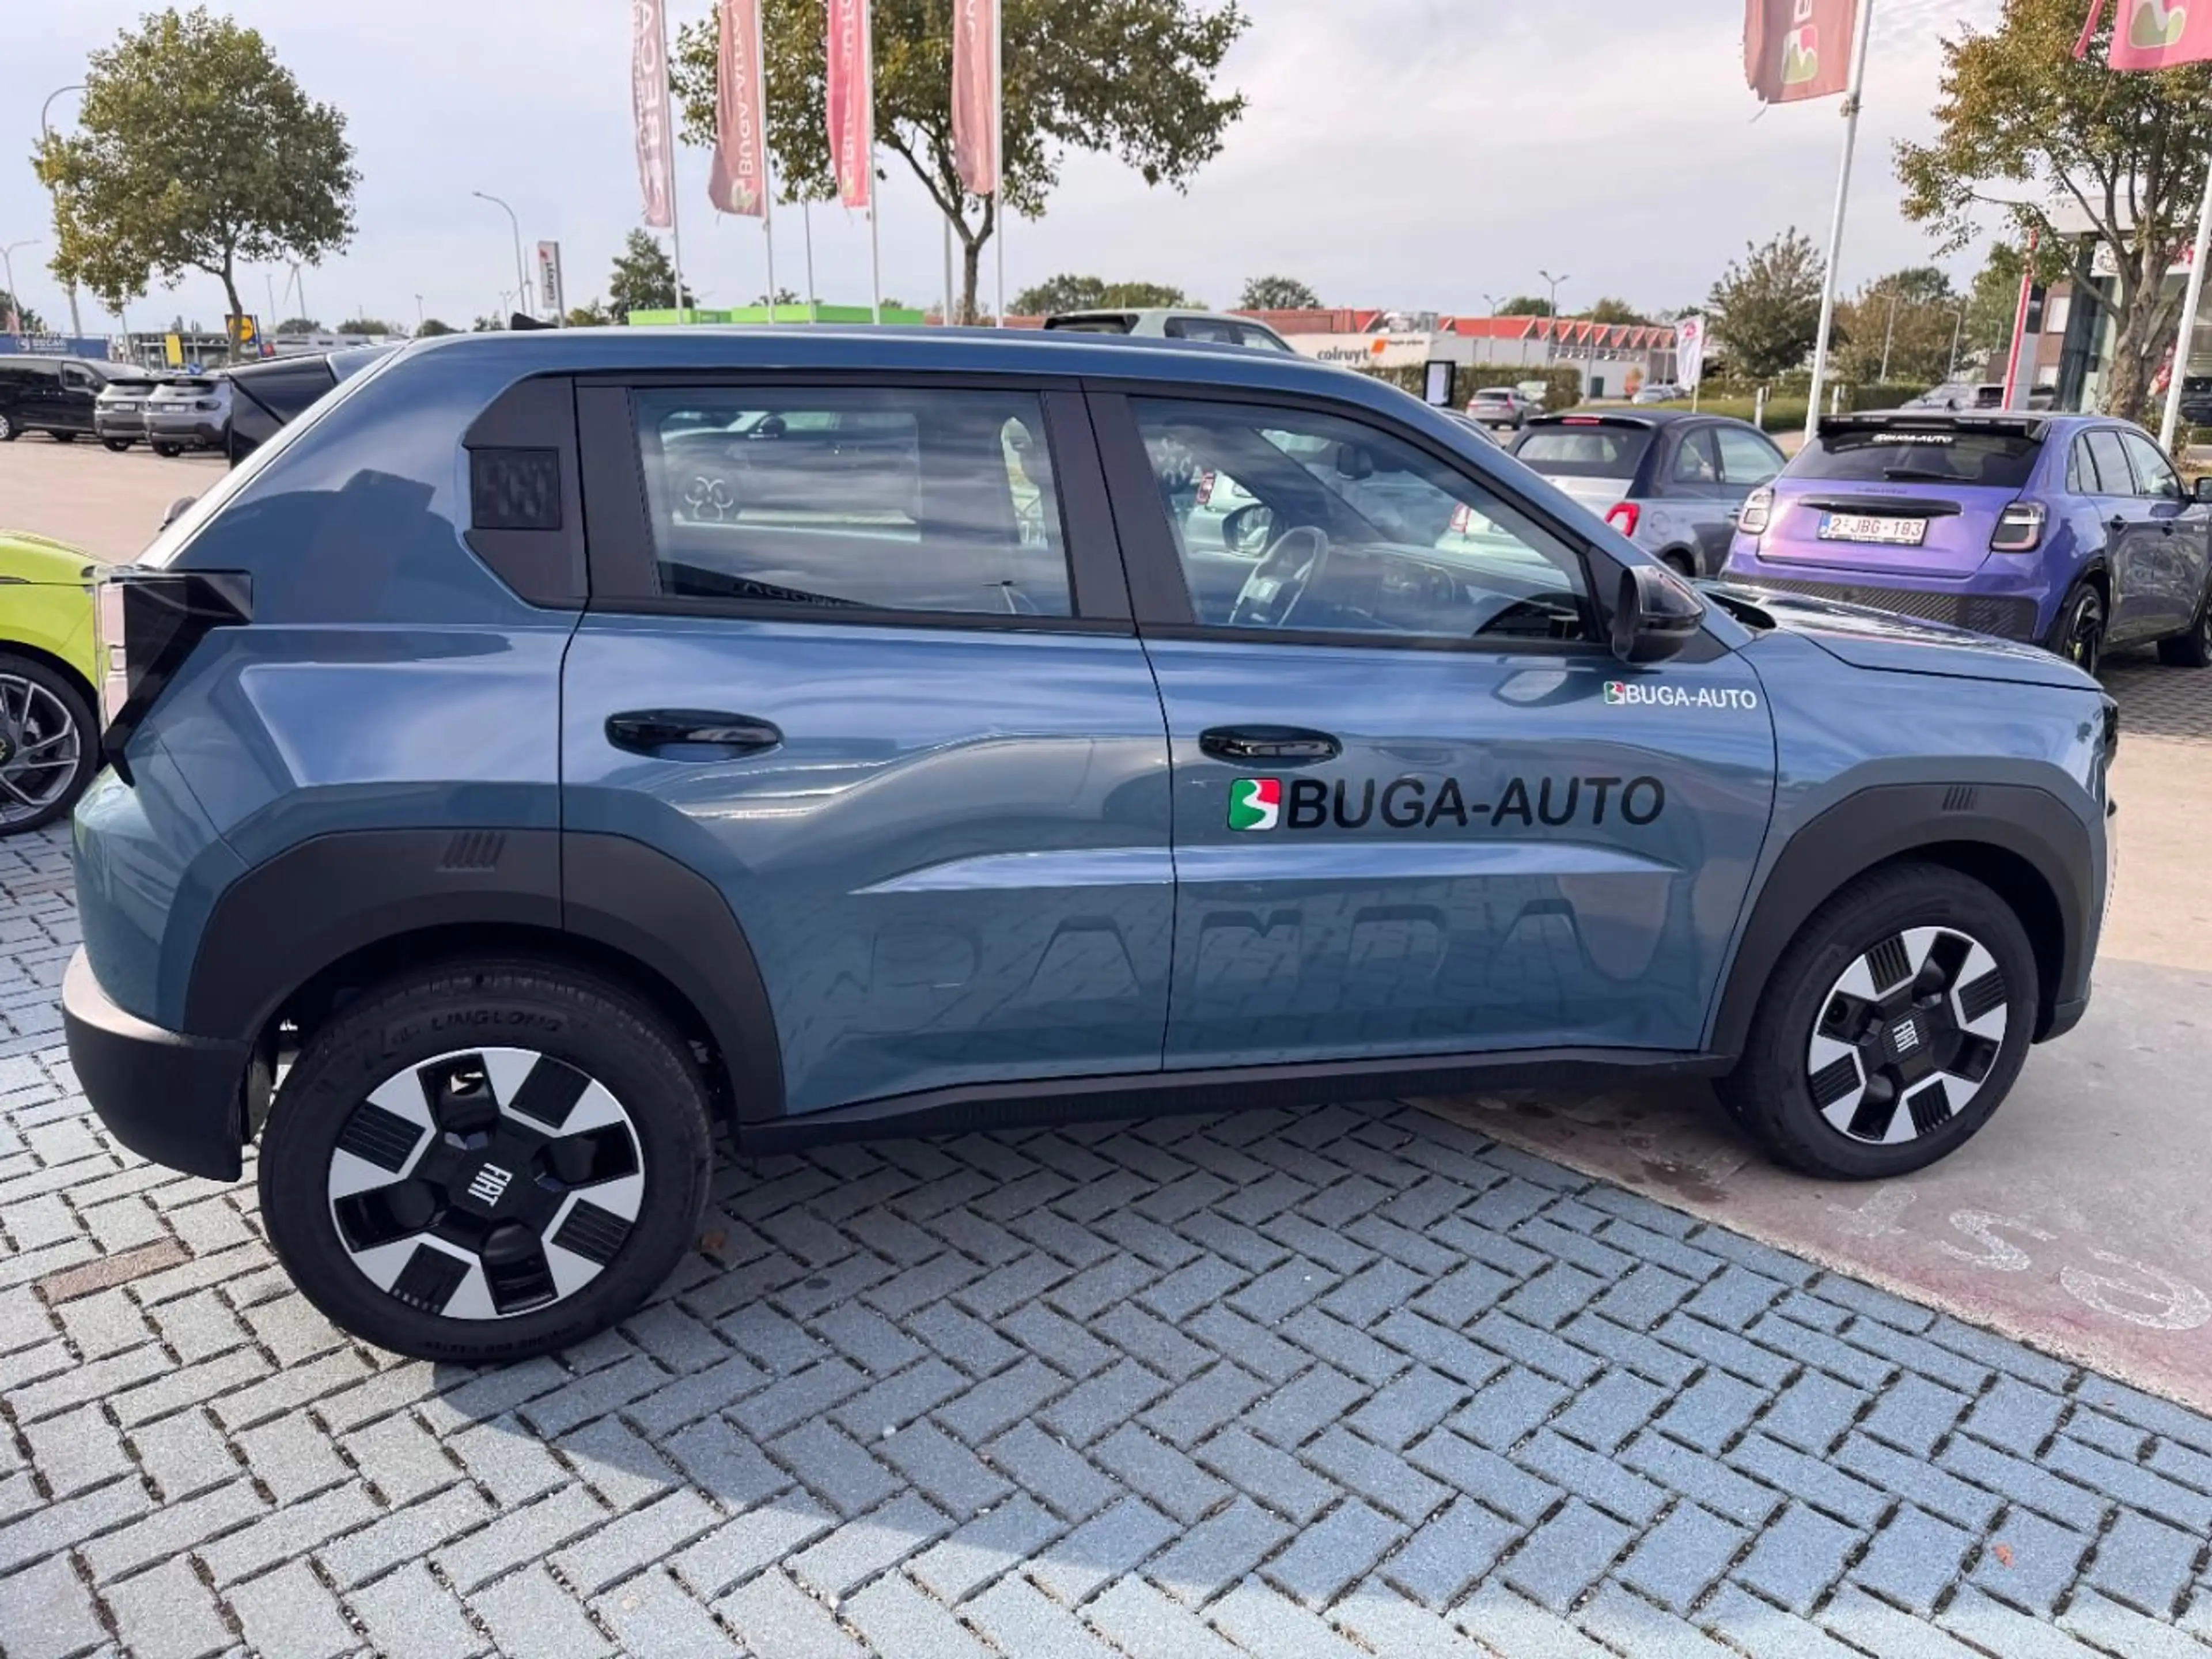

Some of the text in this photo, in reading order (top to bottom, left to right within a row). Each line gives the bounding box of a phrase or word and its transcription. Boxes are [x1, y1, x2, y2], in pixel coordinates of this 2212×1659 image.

[1317, 346, 1369, 363] colruyt
[1624, 684, 1758, 709] BUGA-AUTO
[1287, 775, 1665, 830] BUGA-AUTO
[431, 1009, 565, 1032] LINGLONG
[1892, 1018, 1919, 1054] FIAT
[468, 1162, 513, 1208] FIAT
